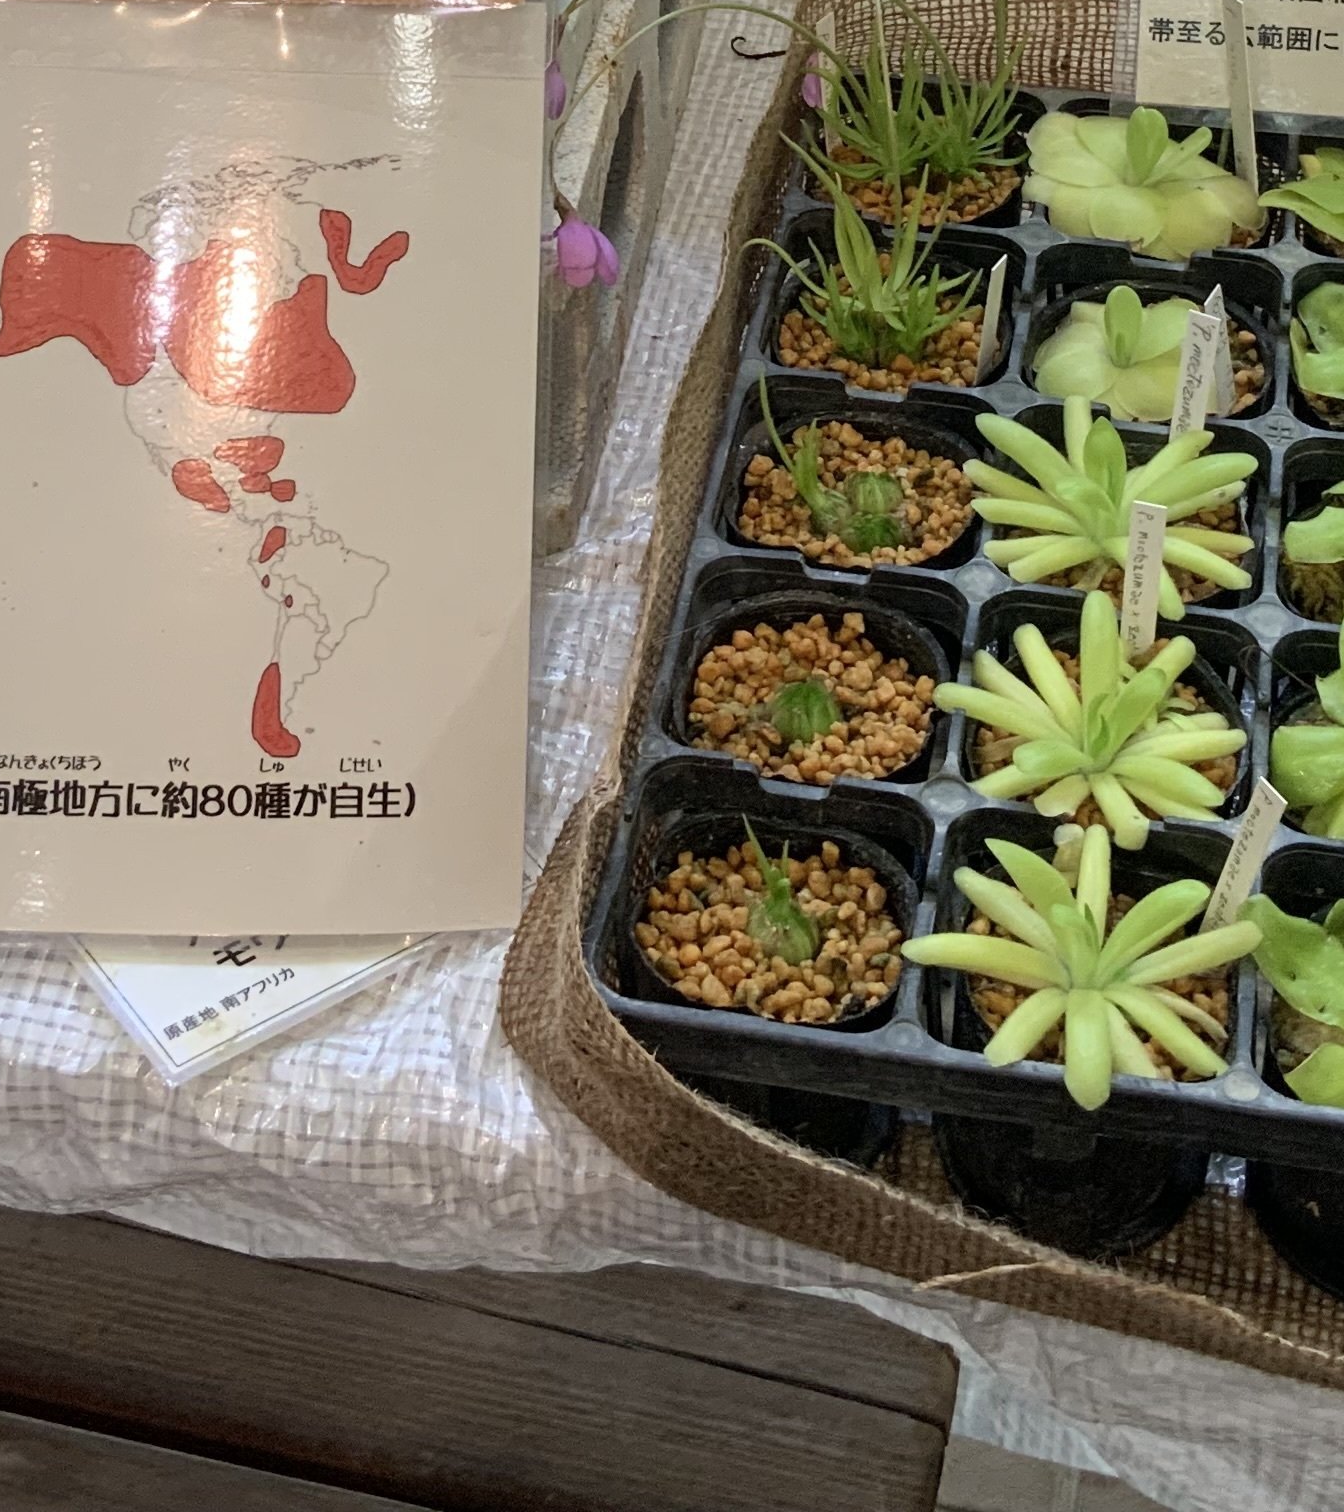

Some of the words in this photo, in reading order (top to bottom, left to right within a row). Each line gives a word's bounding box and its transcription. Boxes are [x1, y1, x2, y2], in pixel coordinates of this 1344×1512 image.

[167, 756, 191, 773] やく
[258, 756, 285, 774] しゅ
[339, 757, 382, 774] じせい
[163, 1006, 219, 1040] 原産地
[219, 967, 295, 1011] 南アフリカ
